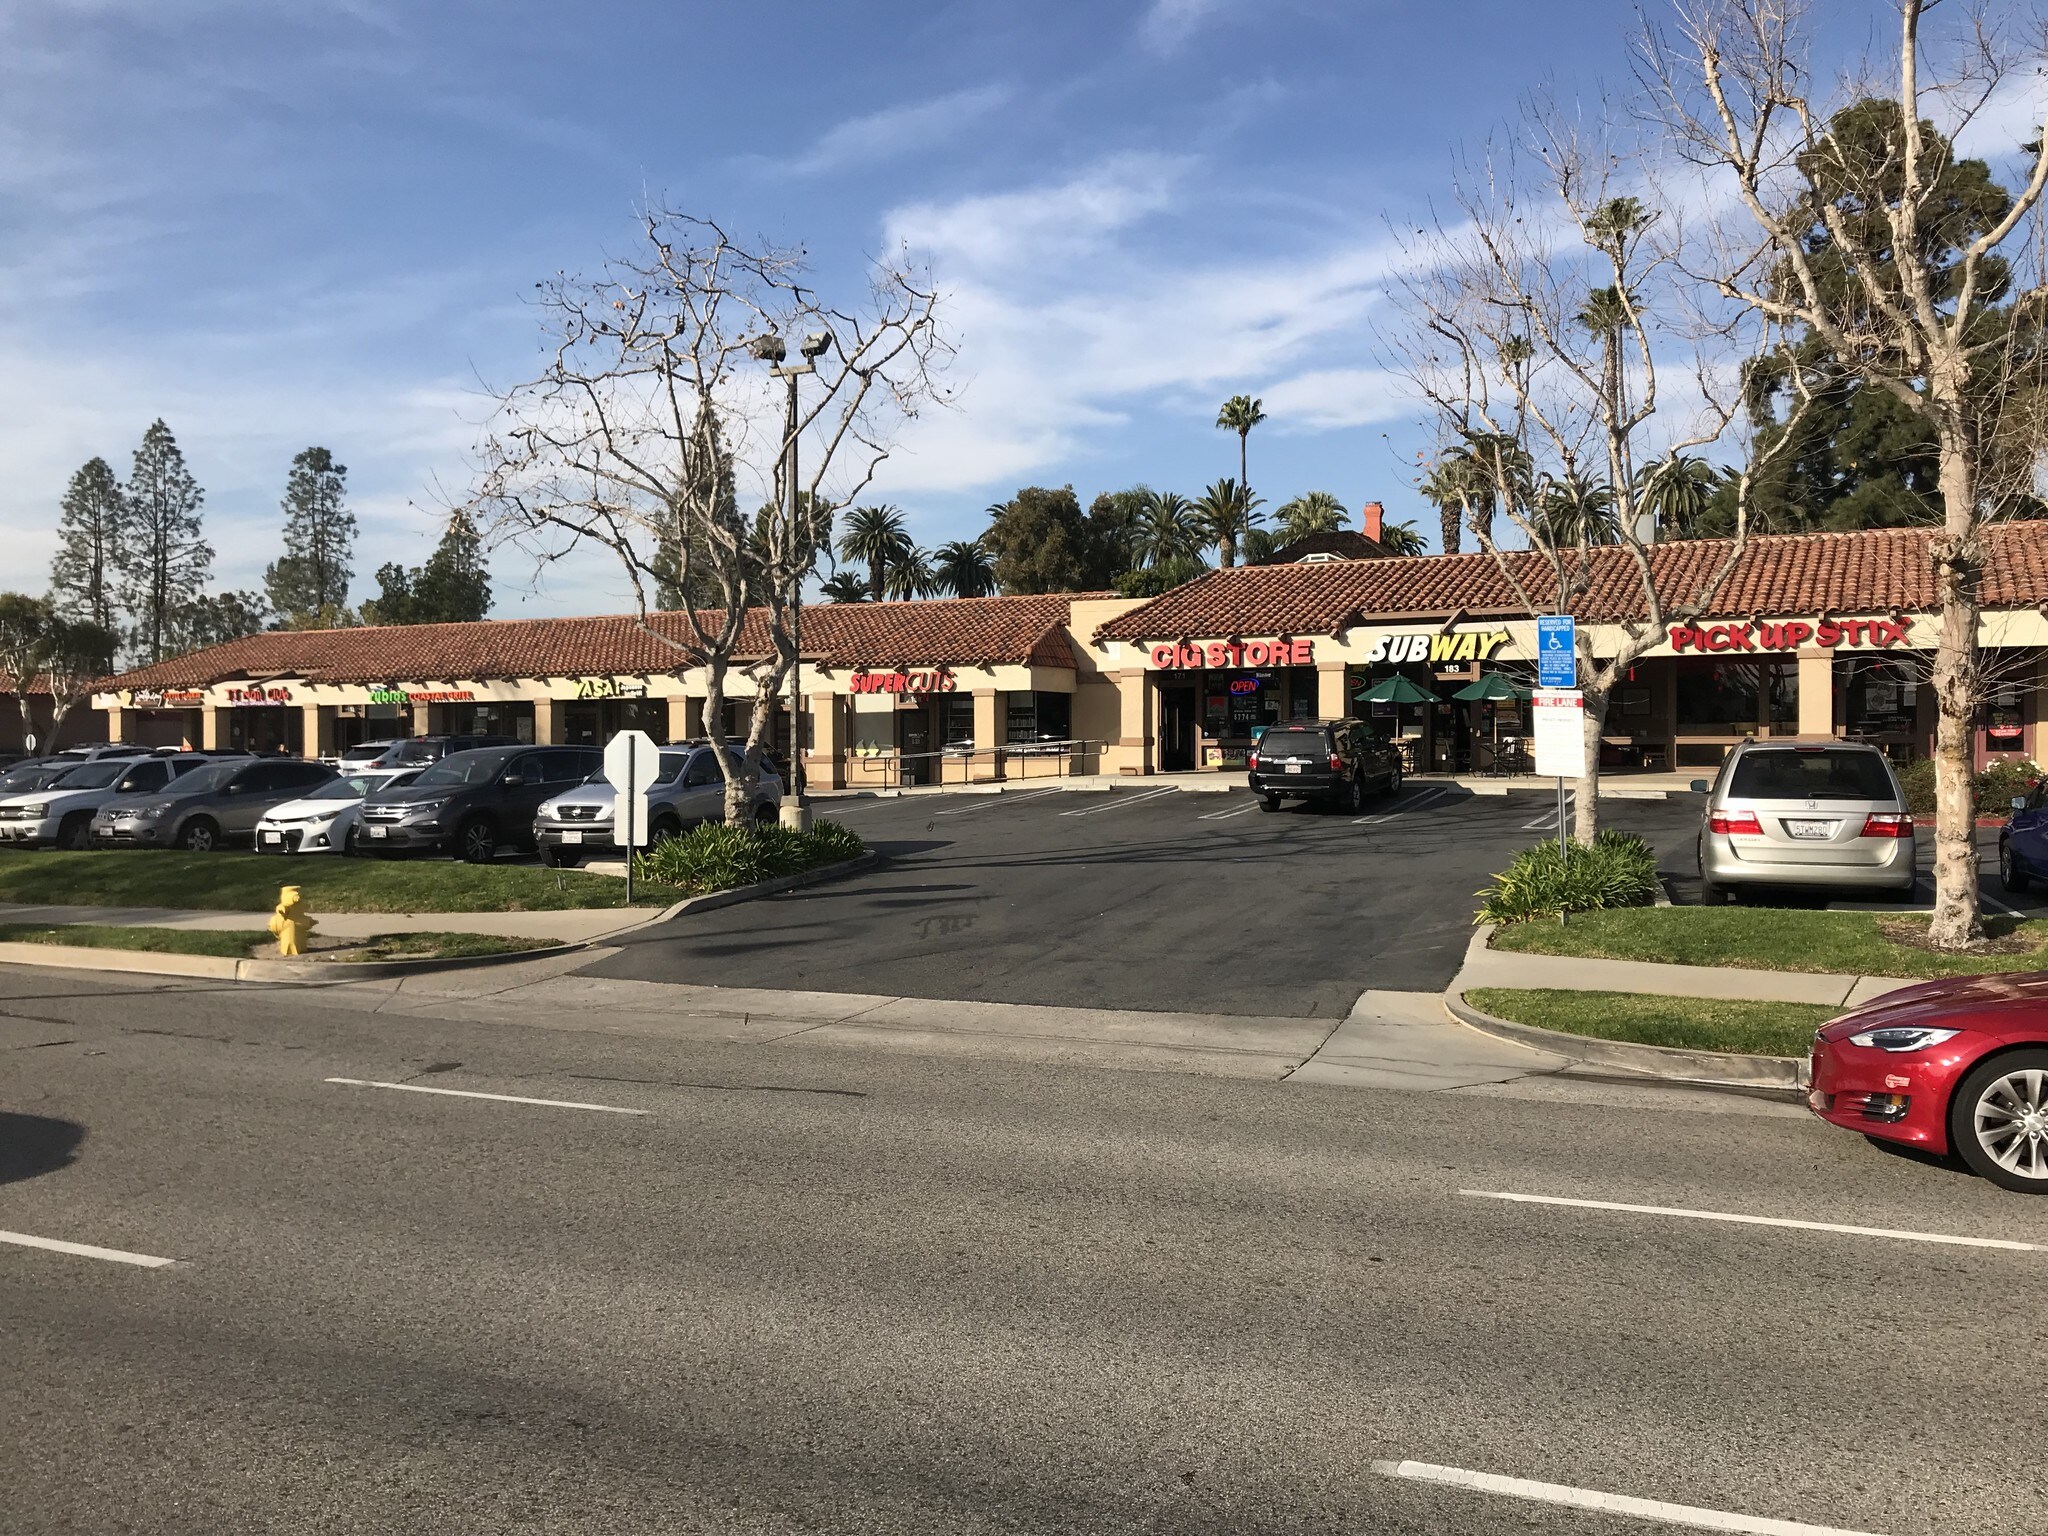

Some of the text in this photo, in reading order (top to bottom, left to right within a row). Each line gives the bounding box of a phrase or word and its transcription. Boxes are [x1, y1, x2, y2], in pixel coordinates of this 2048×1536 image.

[1669, 617, 1911, 651] PICK UP STIX
[1151, 640, 1311, 668] CIG STORE
[1365, 631, 1510, 663] SUBWAY
[1444, 665, 1460, 673] 183
[849, 671, 955, 693] SUPERCUTS
[1230, 680, 1257, 692] OPEN
[408, 692, 445, 701] COASTAL
[447, 691, 470, 699] GRILL
[1538, 697, 1578, 707] FIRE LANE
